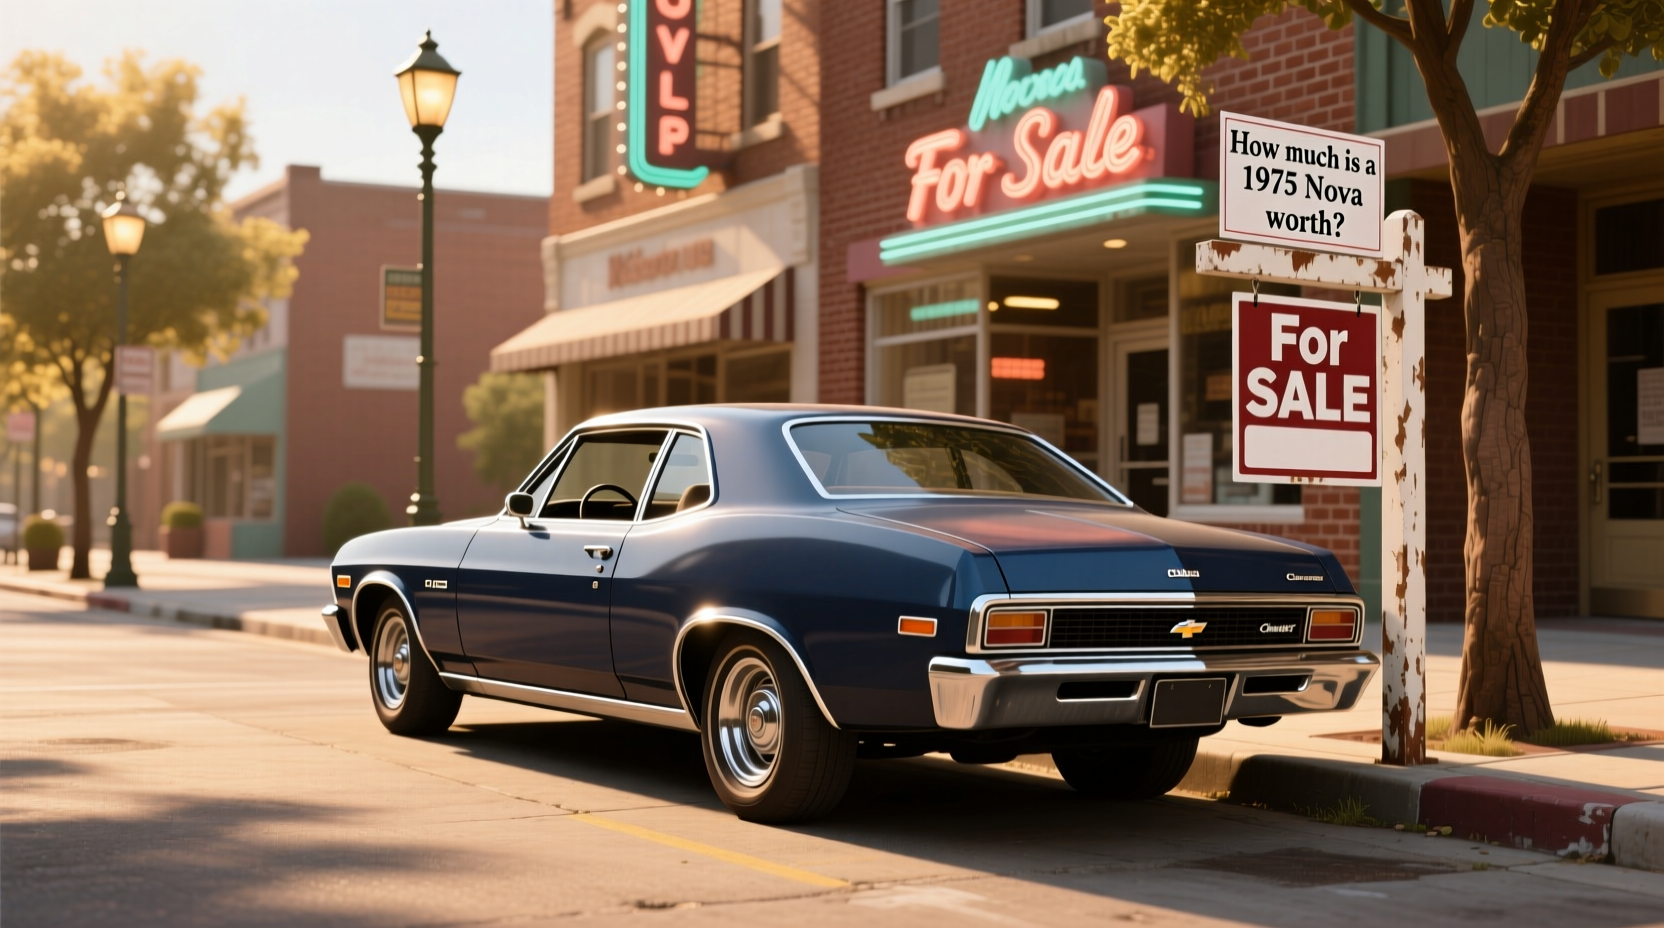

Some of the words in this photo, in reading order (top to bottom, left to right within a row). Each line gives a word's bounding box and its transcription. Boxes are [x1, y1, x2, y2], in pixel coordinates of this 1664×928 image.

[905, 128, 998, 223] For
[1000, 84, 1146, 199] Sale
[1230, 129, 1280, 160] How
[1285, 145, 1340, 170] much
[1344, 148, 1360, 173] is
[1365, 158, 1377, 176] a
[1243, 165, 1298, 196] 1975
[1304, 173, 1363, 207] Nova
[1265, 209, 1345, 238] worth?
[1271, 312, 1349, 366] For
[1245, 366, 1371, 424] SALE
